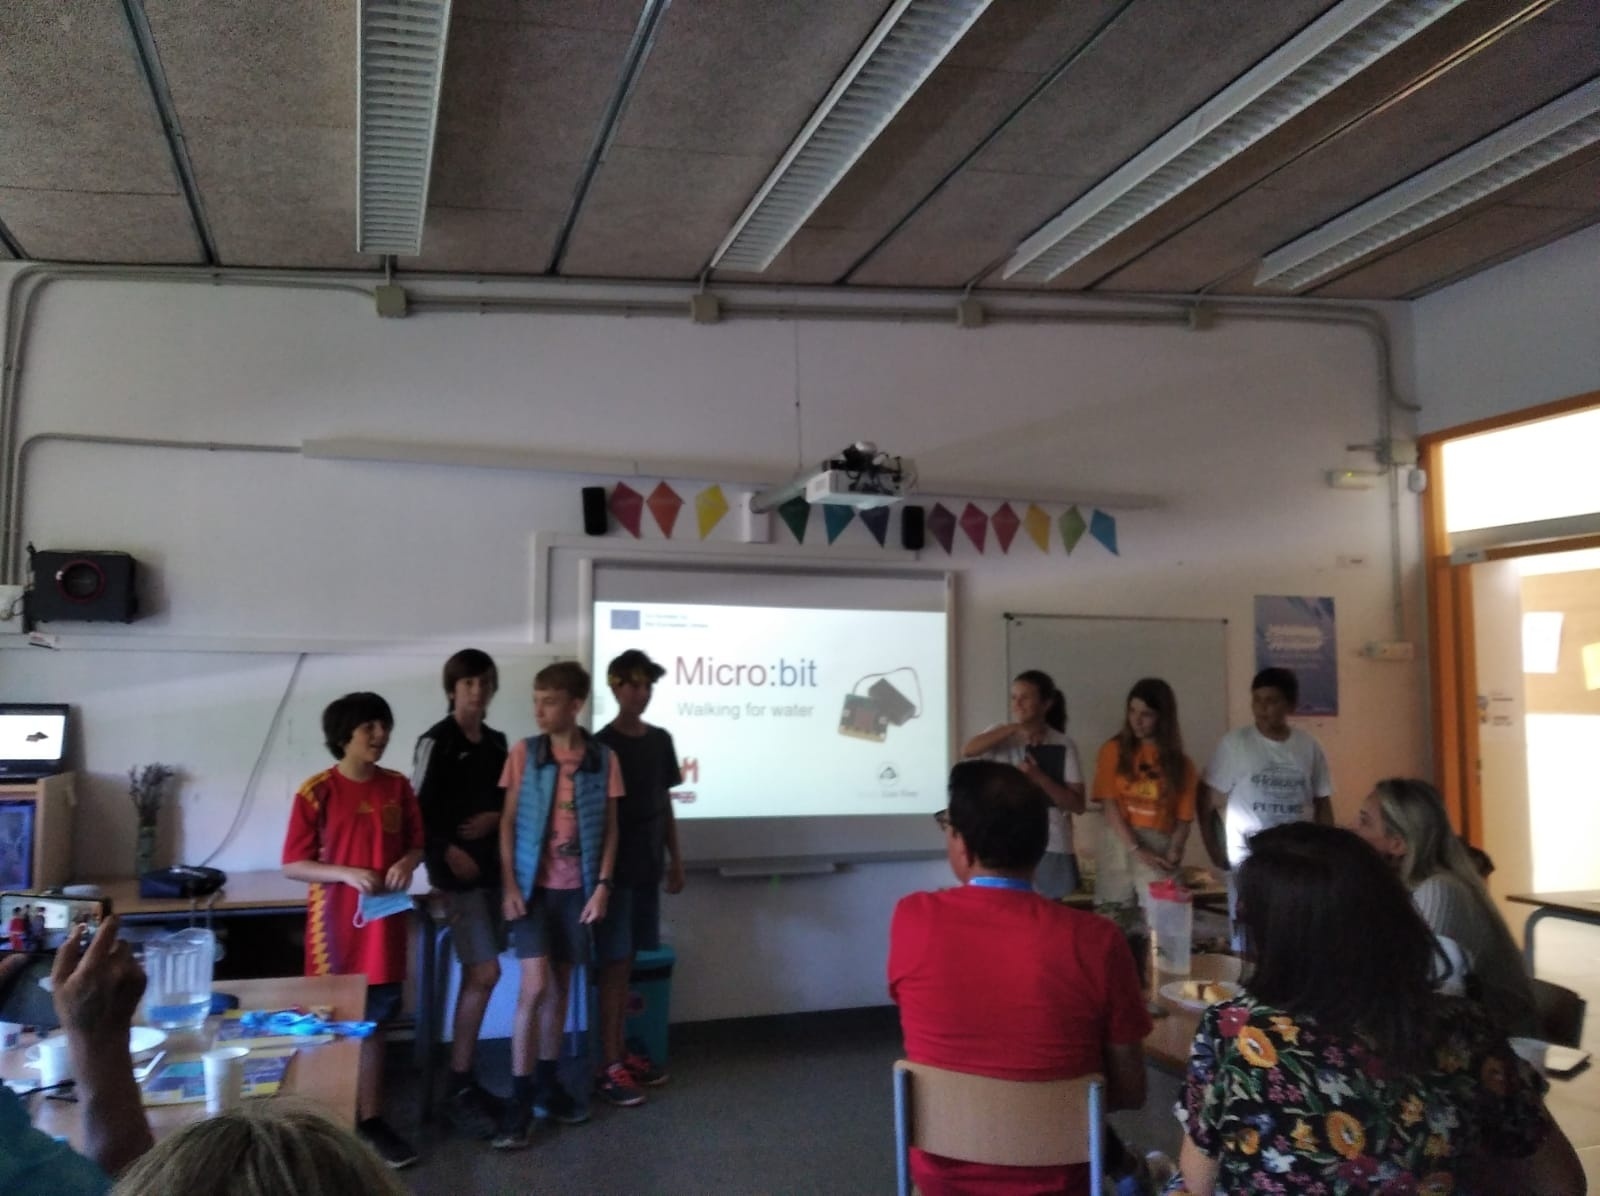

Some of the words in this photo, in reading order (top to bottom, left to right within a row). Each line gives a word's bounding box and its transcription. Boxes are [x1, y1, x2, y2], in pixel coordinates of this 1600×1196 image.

[675, 655, 818, 687] Micro:bit
[678, 702, 741, 720] Walking
[745, 702, 767, 717] for
[770, 703, 815, 717] water
